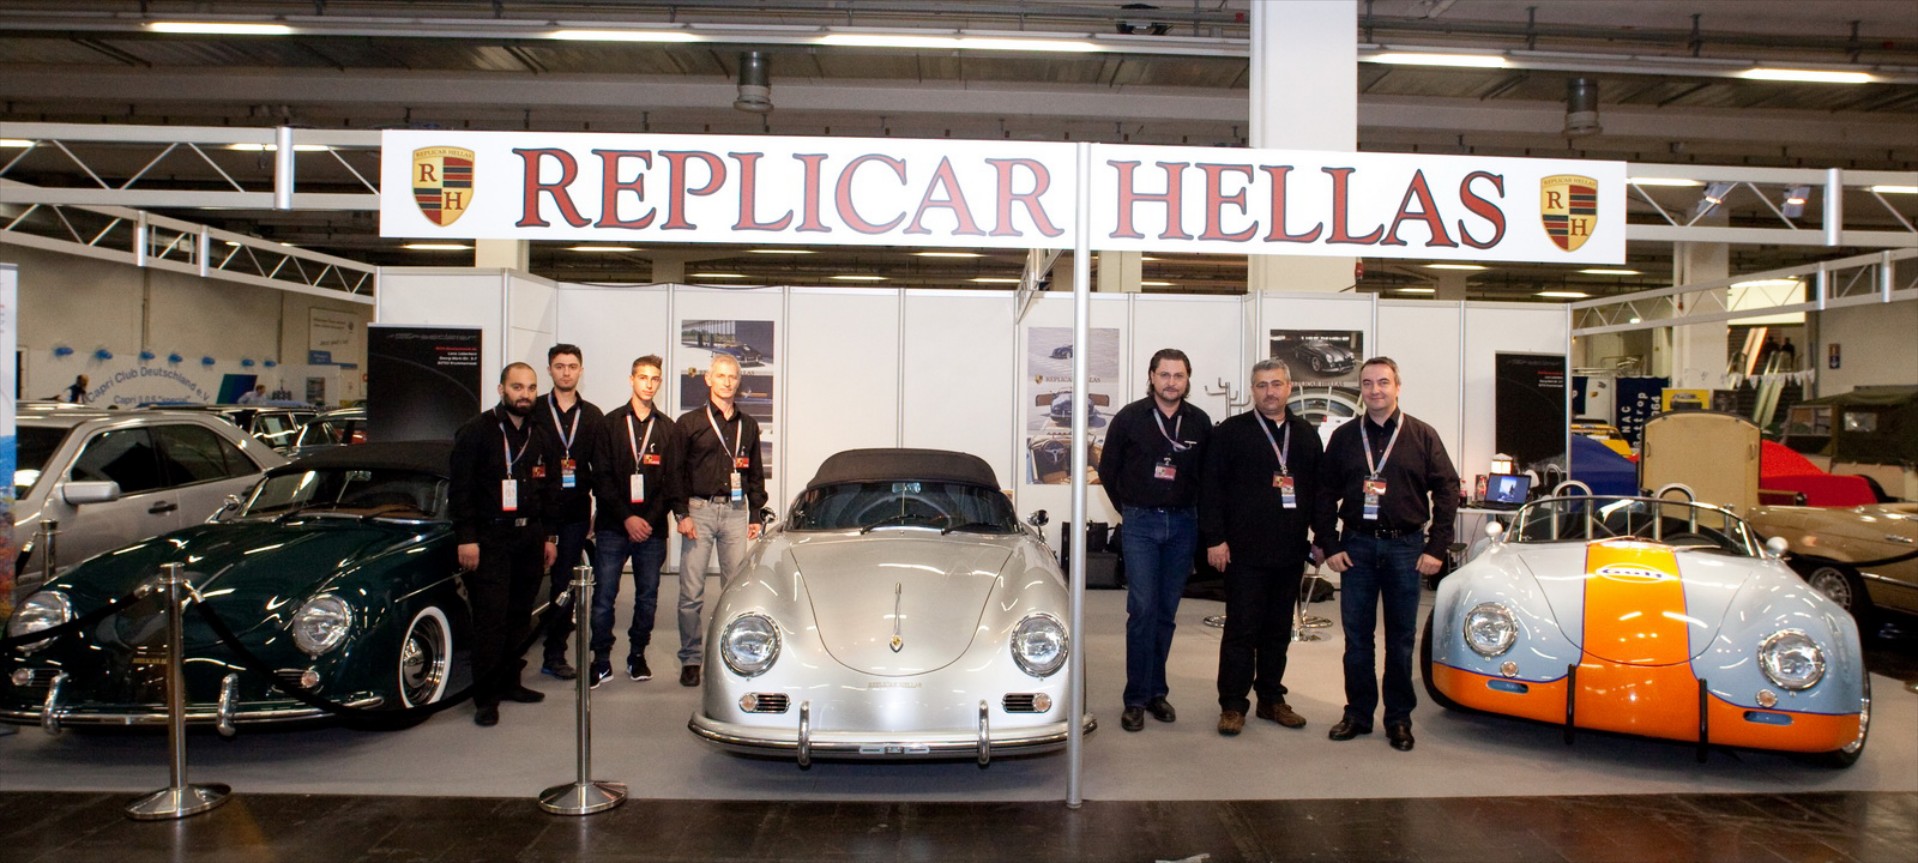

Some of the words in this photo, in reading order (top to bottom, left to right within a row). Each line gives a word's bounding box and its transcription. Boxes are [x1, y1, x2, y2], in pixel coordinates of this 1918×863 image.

[418, 163, 437, 182] R
[444, 192, 463, 210] H
[512, 147, 1065, 237] REPLICAR
[1107, 159, 1507, 250] HELLAS
[1546, 191, 1564, 209] R
[1570, 218, 1589, 236] H
[86, 377, 114, 403] Capri
[115, 368, 138, 383] Club
[140, 366, 196, 391] Deutschland
